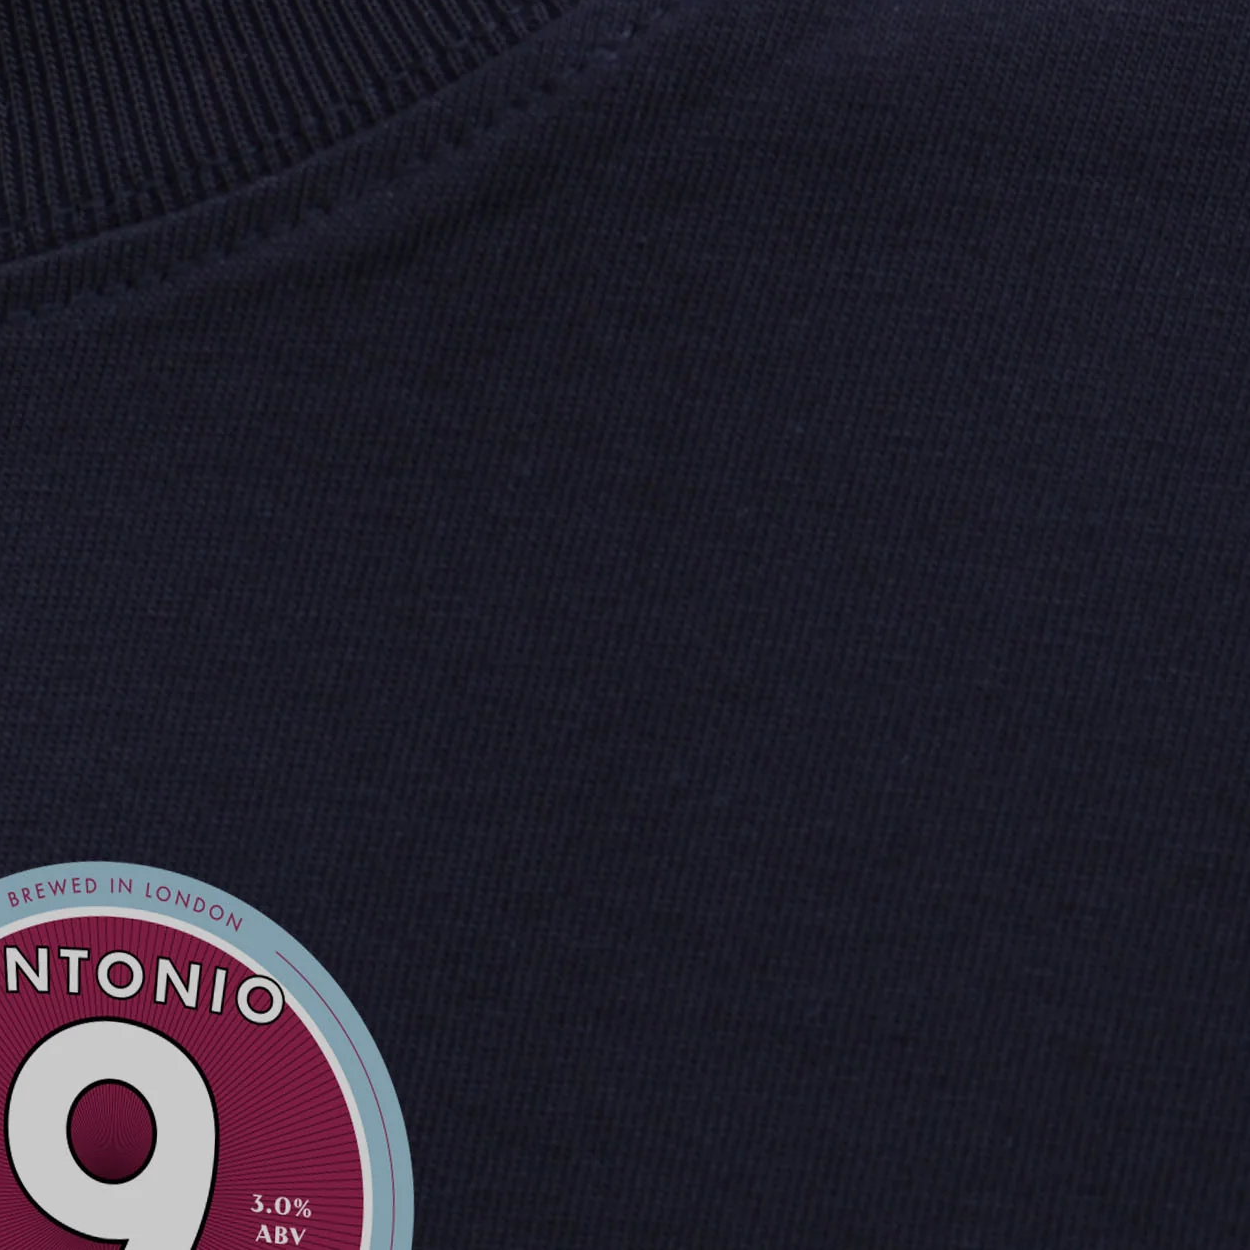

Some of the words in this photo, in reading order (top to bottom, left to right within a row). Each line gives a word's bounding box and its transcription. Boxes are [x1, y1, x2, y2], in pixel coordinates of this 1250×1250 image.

[7, 877, 98, 908] BREWED
[110, 878, 133, 894] IN
[145, 882, 243, 932] LONDON
[250, 1193, 312, 1218] 3.0%
[255, 1223, 306, 1246] ABV
